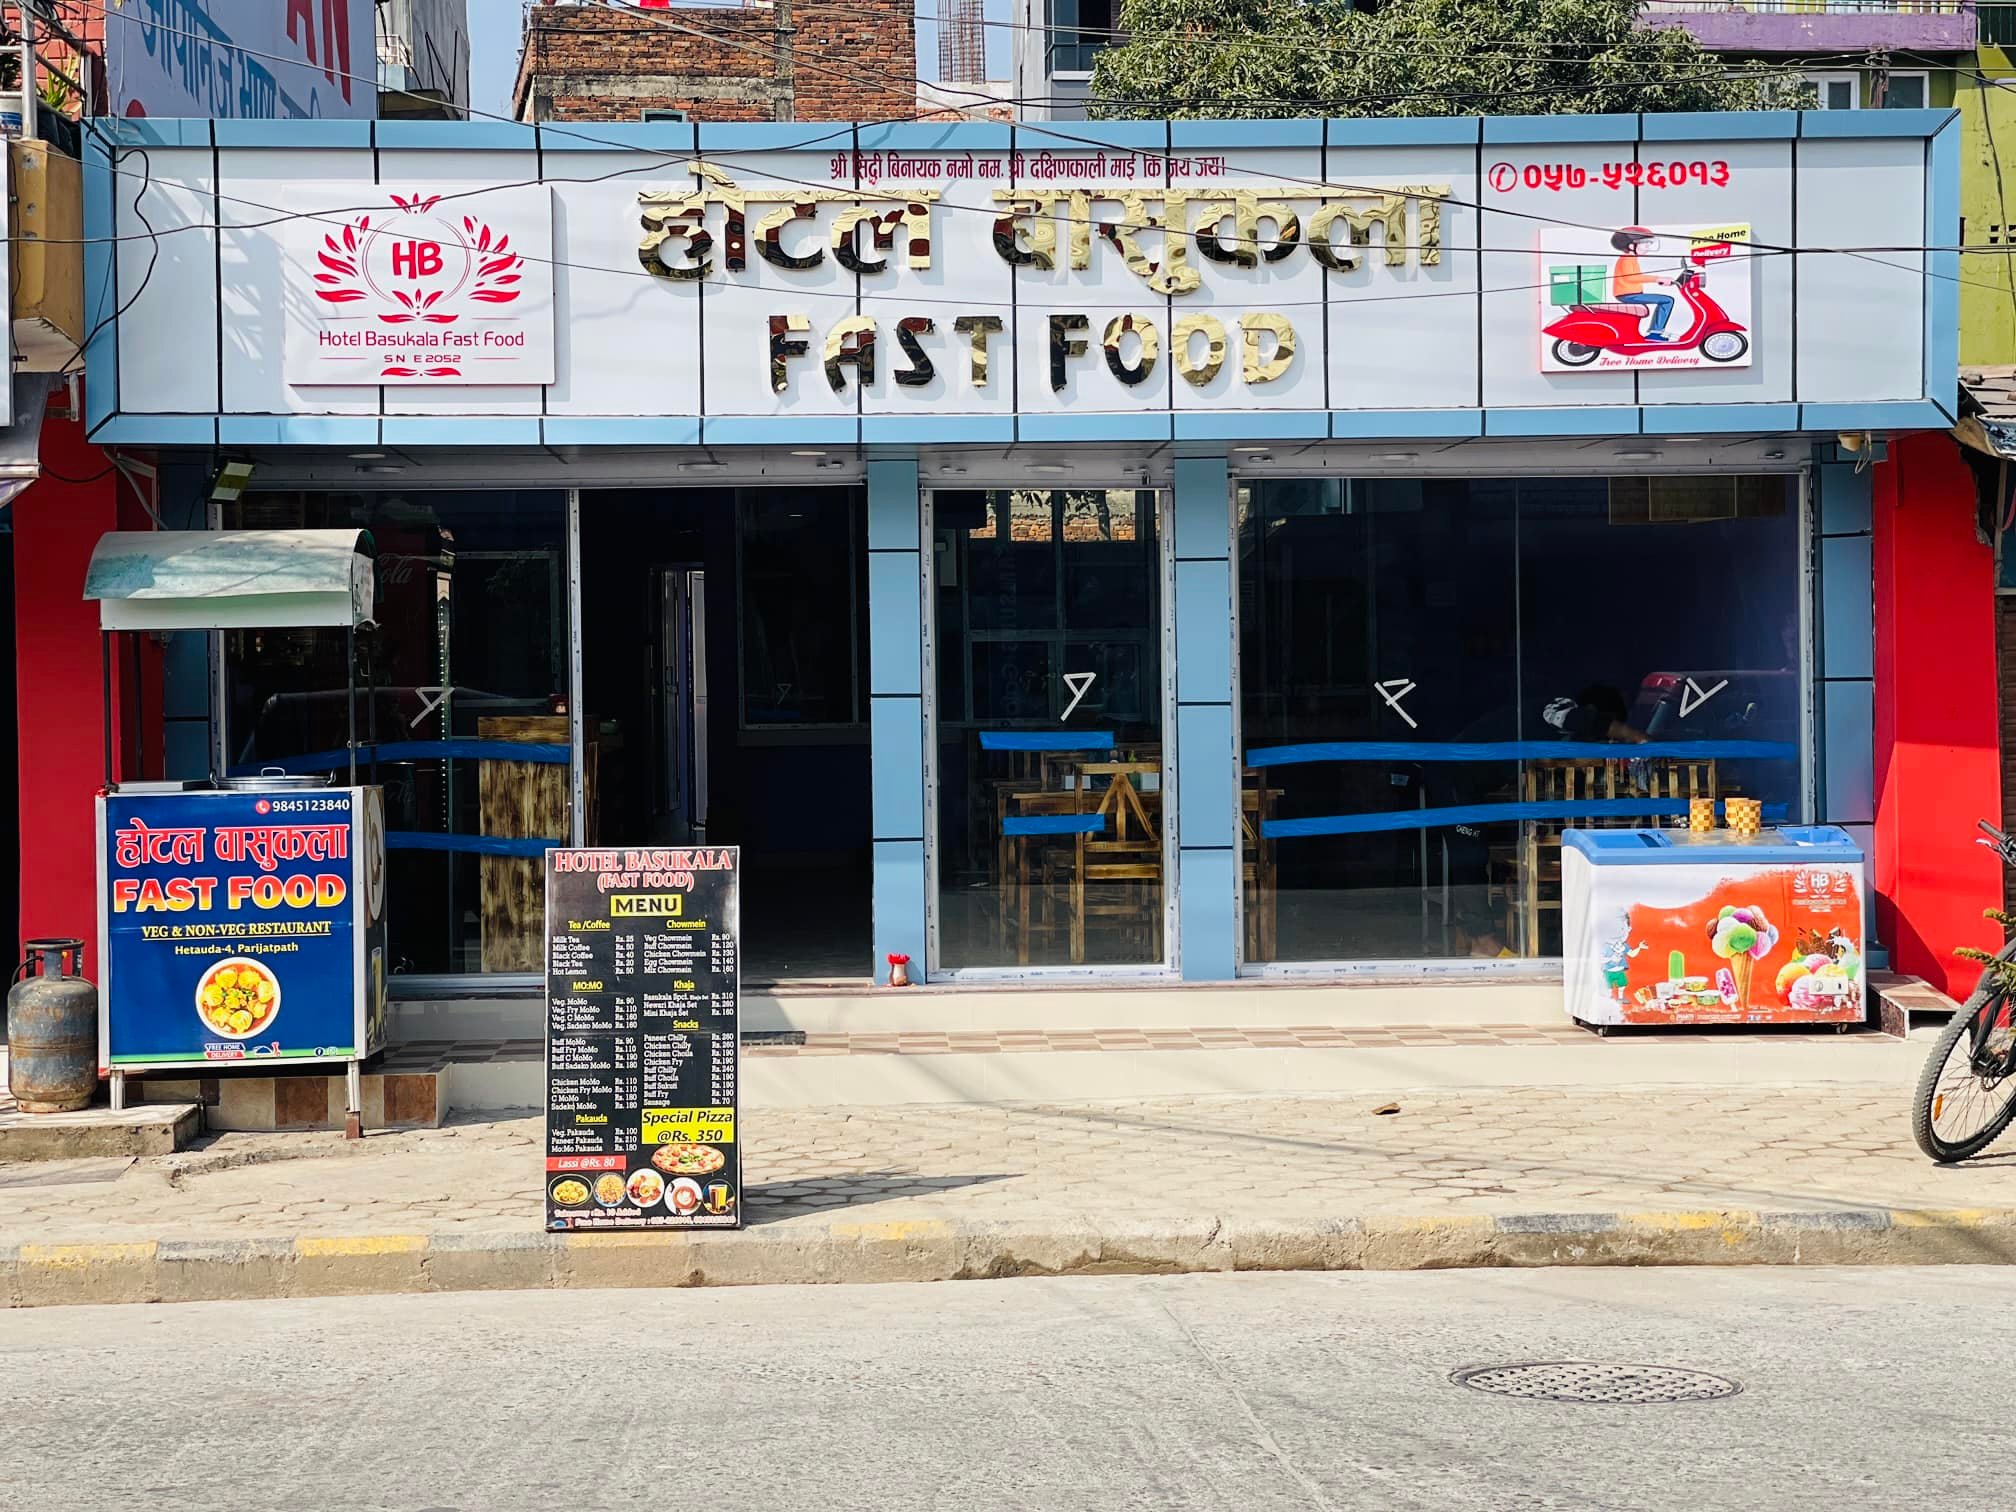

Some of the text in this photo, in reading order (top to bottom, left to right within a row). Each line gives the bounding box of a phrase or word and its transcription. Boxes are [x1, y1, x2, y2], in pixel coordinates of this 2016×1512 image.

[831, 152, 848, 180] श्री
[887, 152, 942, 179] बिनायक
[946, 153, 974, 179] नमो
[1110, 153, 1137, 181] माई
[637, 160, 1452, 296] होटल वासुकला
[1717, 229, 1746, 240] Home
[391, 241, 444, 280] HB
[318, 330, 525, 348] Hotel Basukala Fast Food
[767, 311, 1297, 394] FAST FOOD
[1600, 356, 1700, 366] Free Home Delivery
[272, 799, 350, 813] 9845123840
[115, 817, 350, 872] होटल वासुकला
[554, 850, 733, 873] HOTEL BASUKALA
[597, 871, 695, 894] (FAST FOOD)
[1810, 873, 1830, 889] HB
[113, 874, 347, 914] FAST FOOD
[615, 898, 678, 914] MENU
[142, 920, 331, 938] VEG & NON-VEG RESTAURANT
[568, 921, 581, 929] Tea
[666, 919, 706, 929] Chowmein
[174, 942, 299, 956] Hetauda-4, Parijatpath
[673, 980, 695, 990] Khaja
[672, 1020, 699, 1029] Snacks
[643, 1110, 733, 1127] Special Pizza
[657, 1130, 724, 1144] @Rs. 350
[558, 1159, 579, 1168] Lassi
